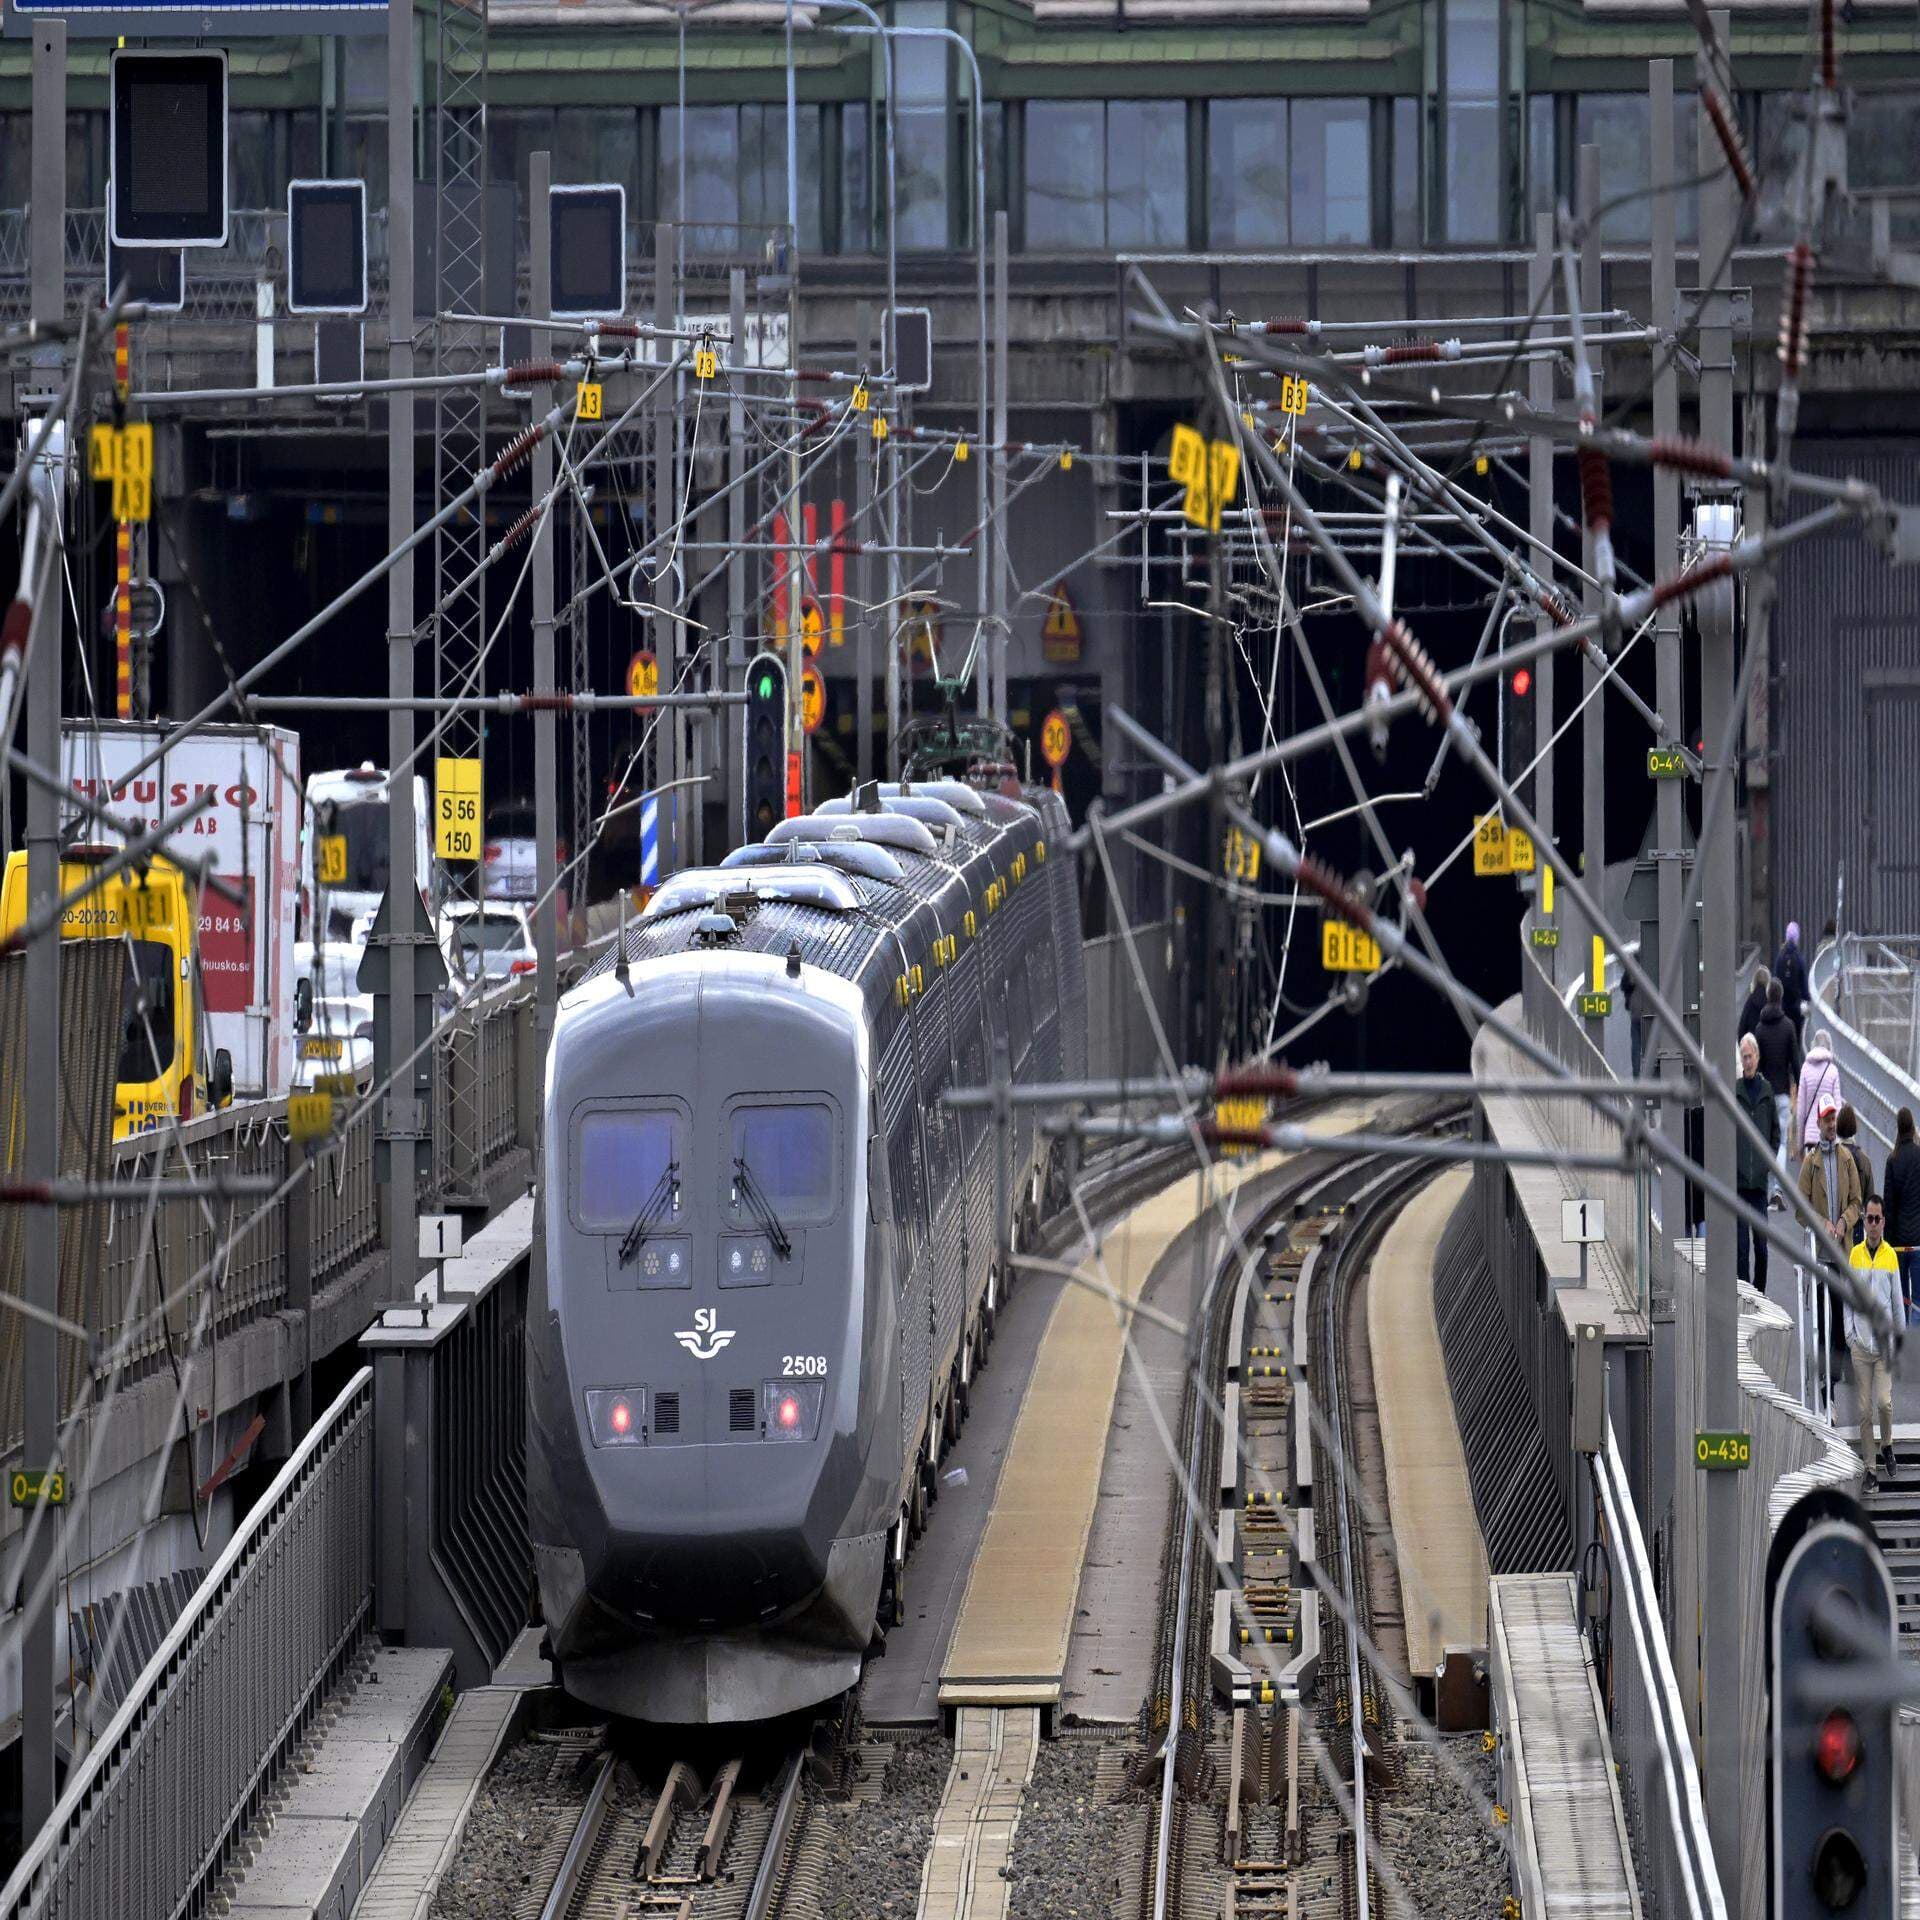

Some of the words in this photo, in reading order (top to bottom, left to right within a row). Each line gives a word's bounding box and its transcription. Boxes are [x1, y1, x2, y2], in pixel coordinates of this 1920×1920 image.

[697, 359, 712, 375] A3
[580, 391, 598, 414] A3
[1286, 386, 1303, 410] B3
[119, 478, 145, 513] A3
[72, 778, 258, 808] HUUSKO
[442, 798, 452, 820] S
[457, 799, 475, 820] 56
[193, 816, 217, 835] AB
[445, 831, 472, 853] 150
[320, 846, 341, 875] A3
[94, 909, 107, 923] 20
[121, 894, 167, 926] A1E1
[199, 915, 212, 931] 29
[215, 916, 230, 932] 84
[1534, 930, 1557, 945] 1-2a
[1328, 933, 1373, 965] B1E1
[1584, 997, 1607, 1013] 1-1a
[1580, 1203, 1586, 1237] 1
[437, 1220, 443, 1253] 1
[694, 1307, 717, 1333] SJ
[782, 1355, 827, 1376] 2508
[1697, 1439, 1748, 1460] 0-43a
